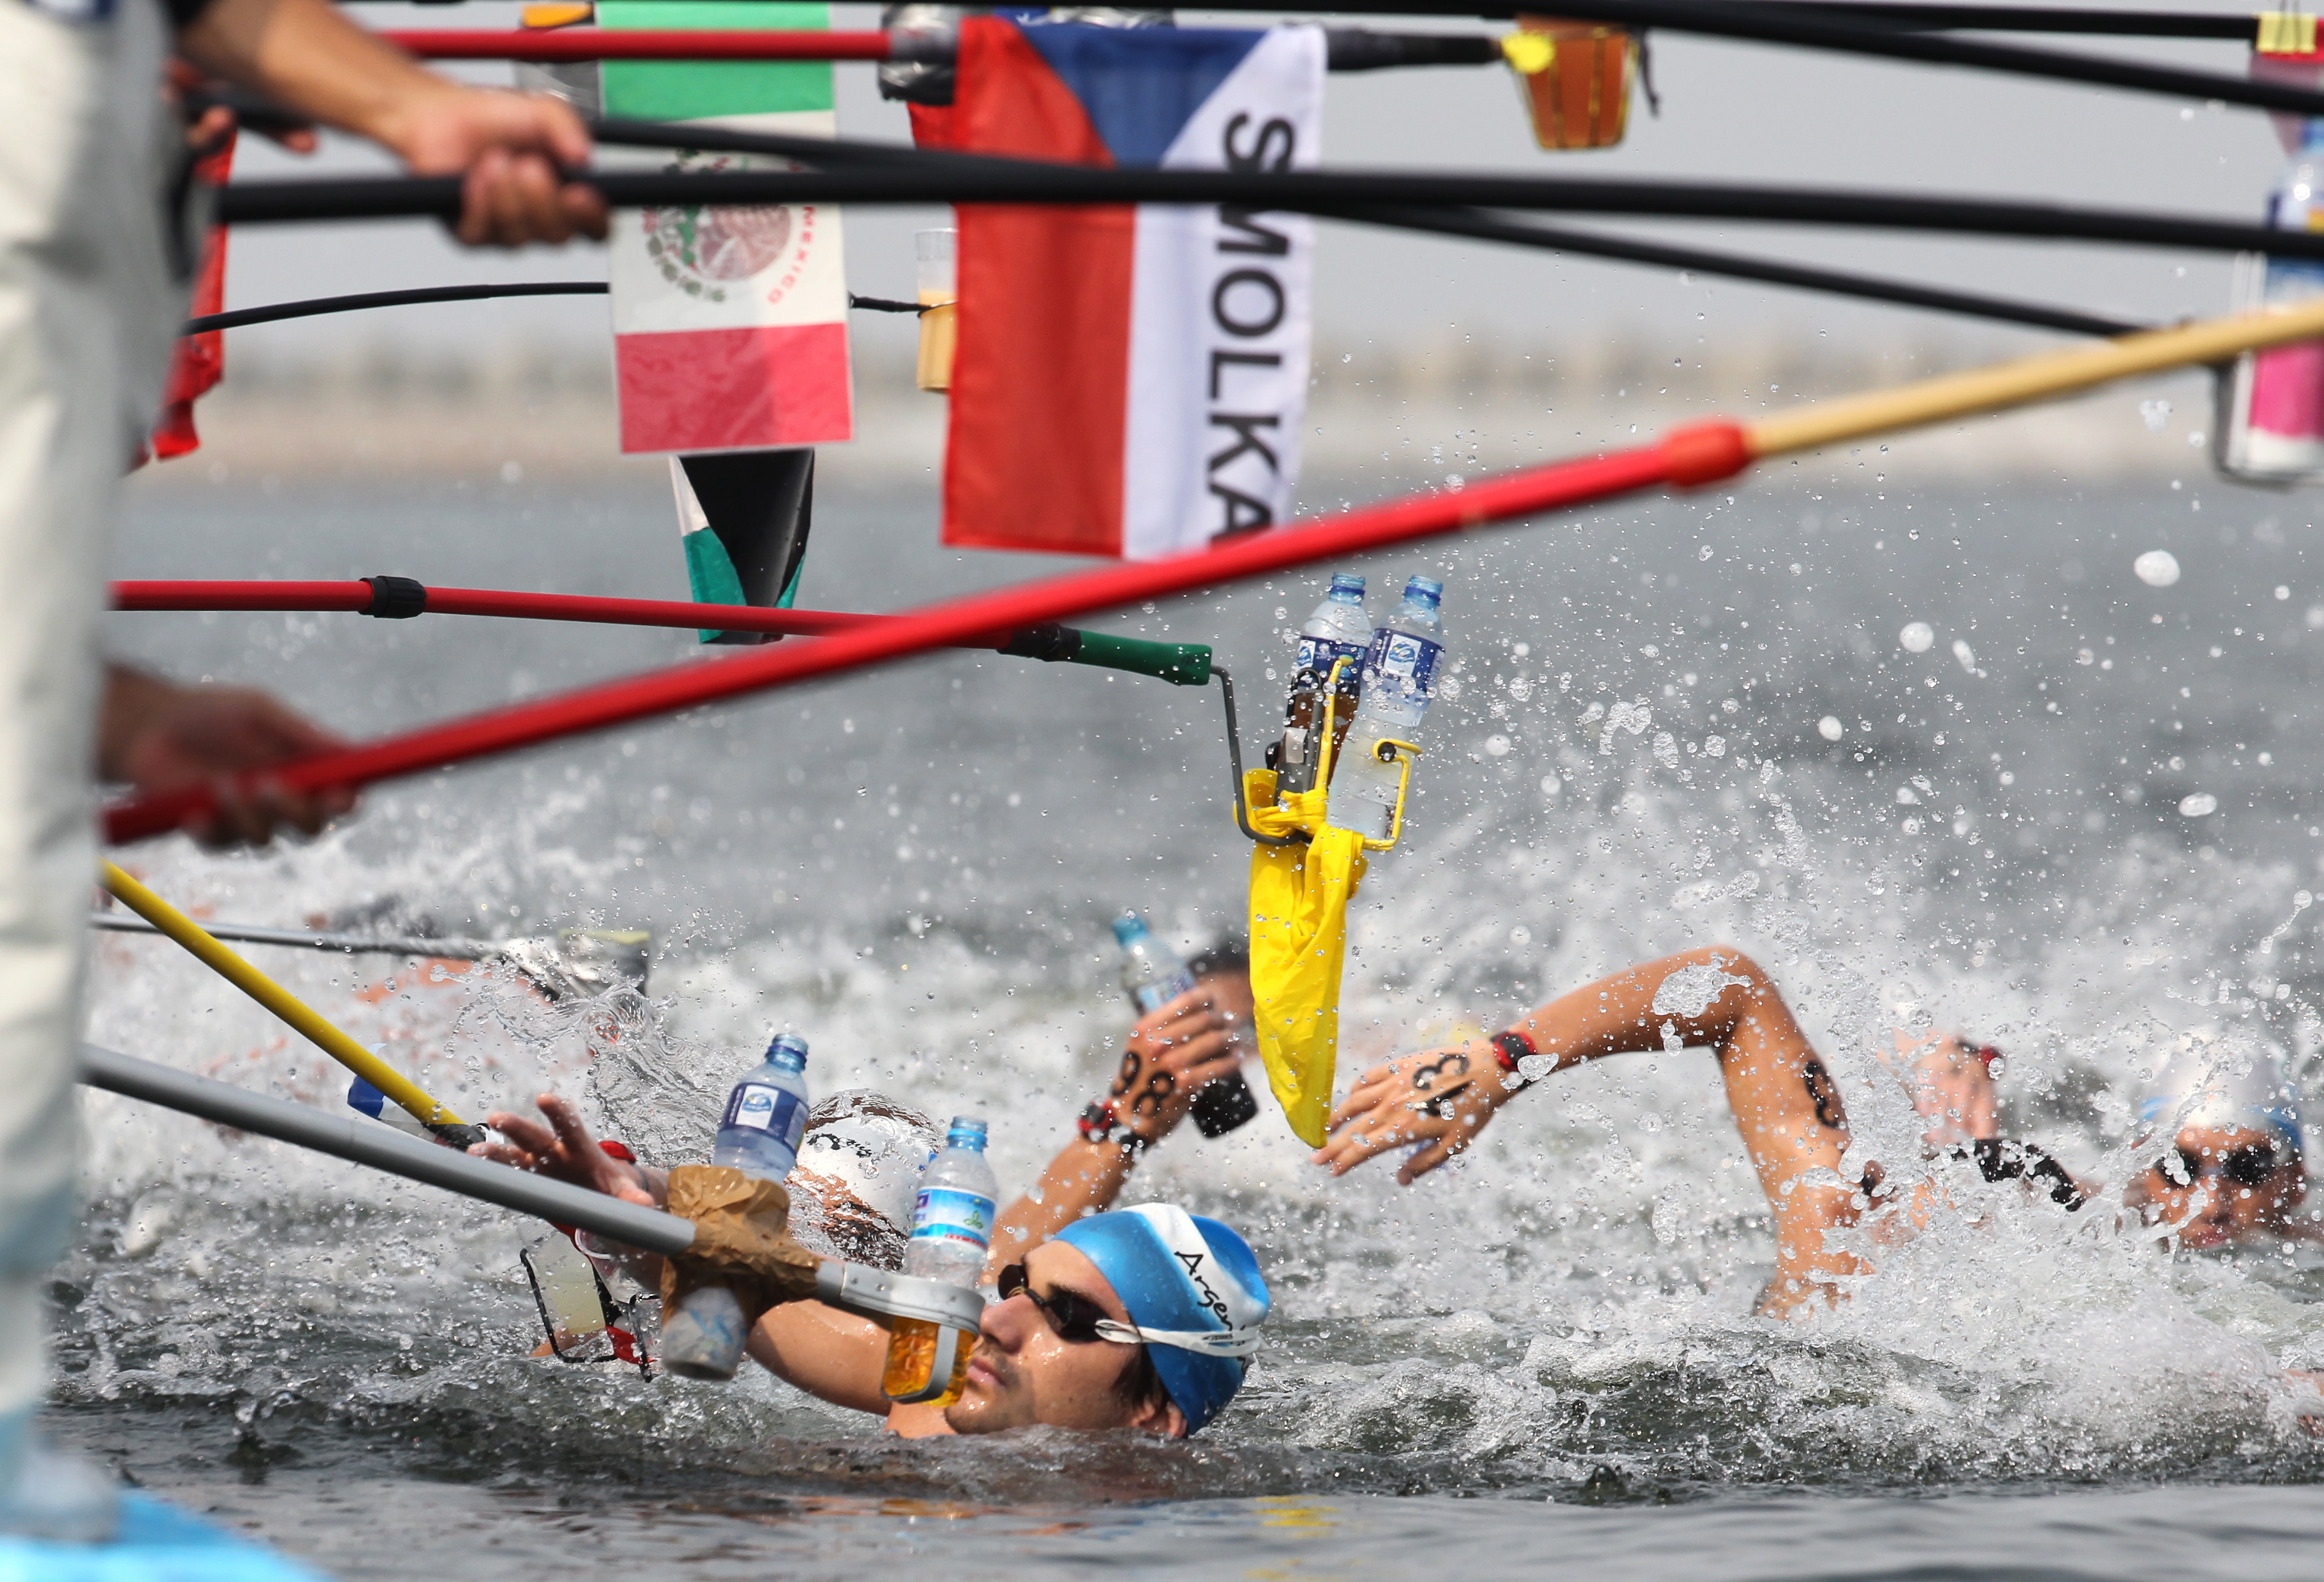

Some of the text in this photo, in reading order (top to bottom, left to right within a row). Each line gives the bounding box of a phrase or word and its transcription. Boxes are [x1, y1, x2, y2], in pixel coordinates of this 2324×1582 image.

[1208, 114, 1292, 547] SMOLKA
[1109, 1051, 1176, 1118] 98
[1413, 1053, 1476, 1117] 13
[1174, 1251, 1246, 1371] Argen
